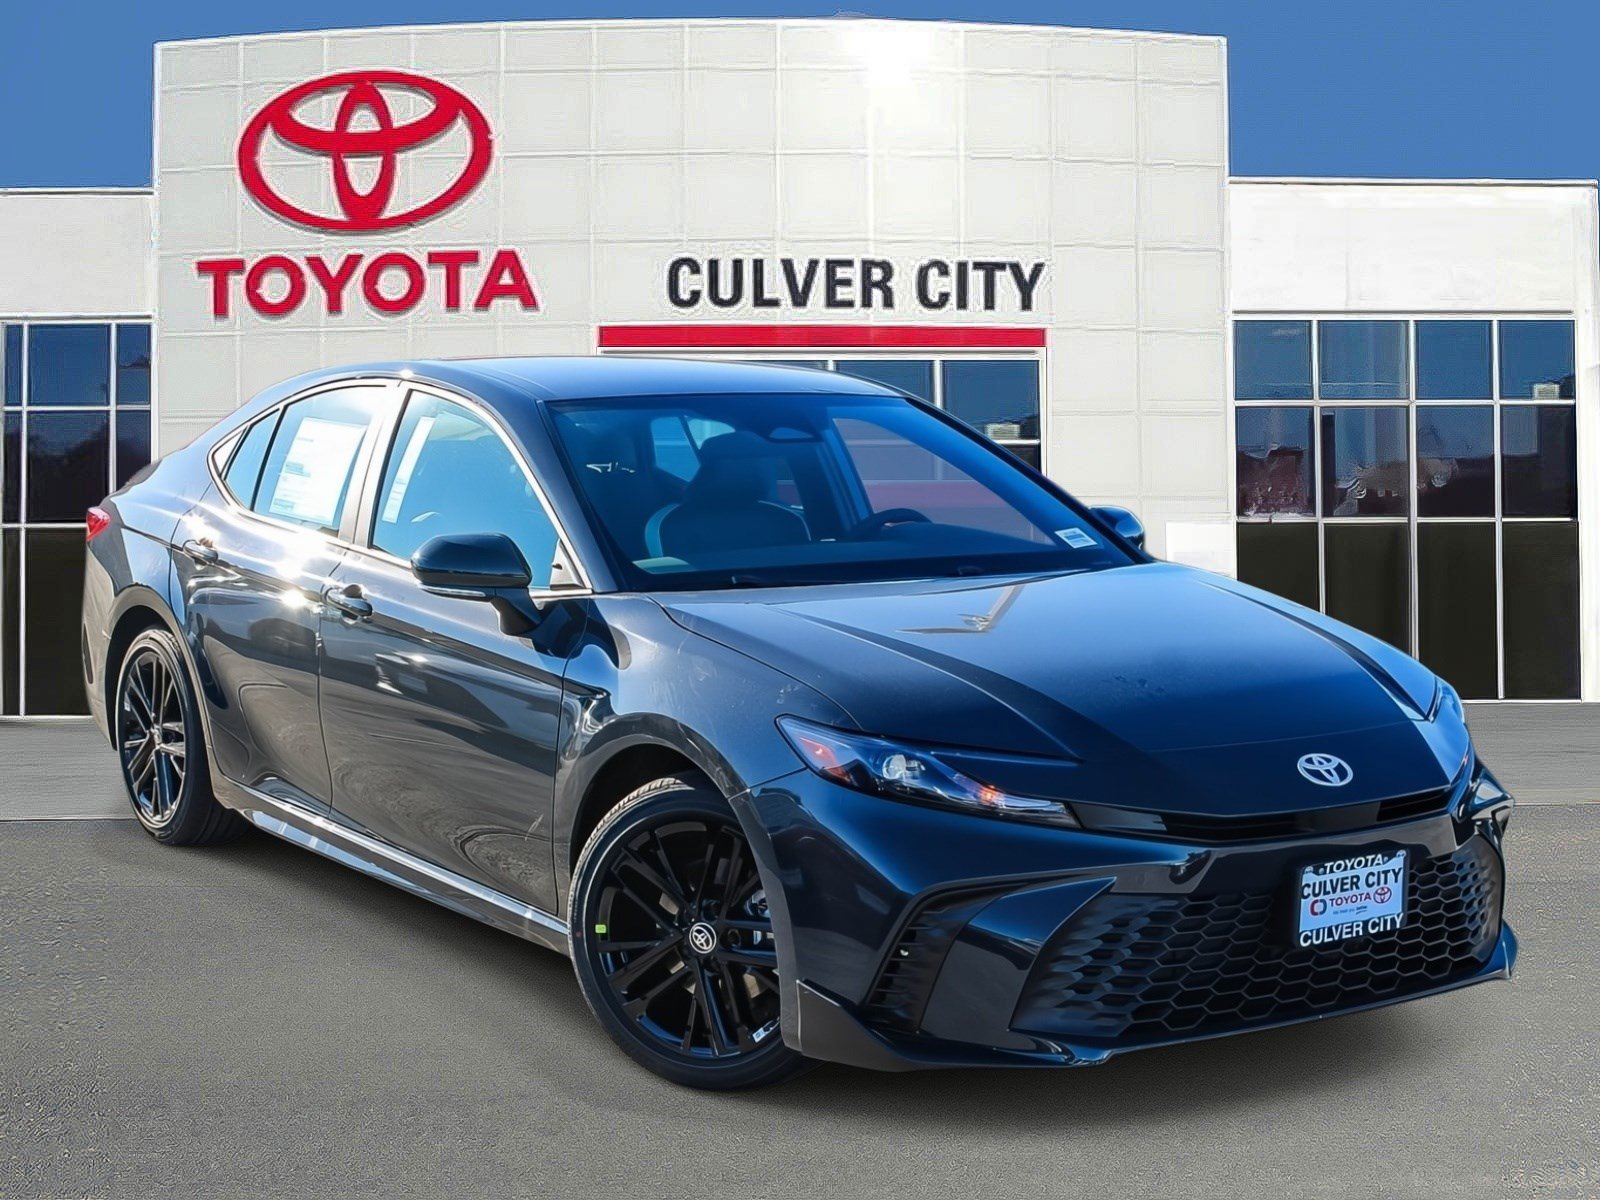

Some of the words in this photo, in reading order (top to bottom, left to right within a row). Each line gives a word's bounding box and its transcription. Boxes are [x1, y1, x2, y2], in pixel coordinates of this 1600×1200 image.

[195, 249, 540, 318] TOYOTA
[667, 257, 895, 309] CULVER
[915, 258, 1046, 311] CITY
[1325, 854, 1383, 874] TOYOTA
[1301, 874, 1361, 900] CULVER
[1364, 867, 1402, 889] CITY
[1330, 892, 1371, 907] TOYOTA
[1300, 921, 1363, 947] CULVER
[1367, 913, 1403, 934] CITY
